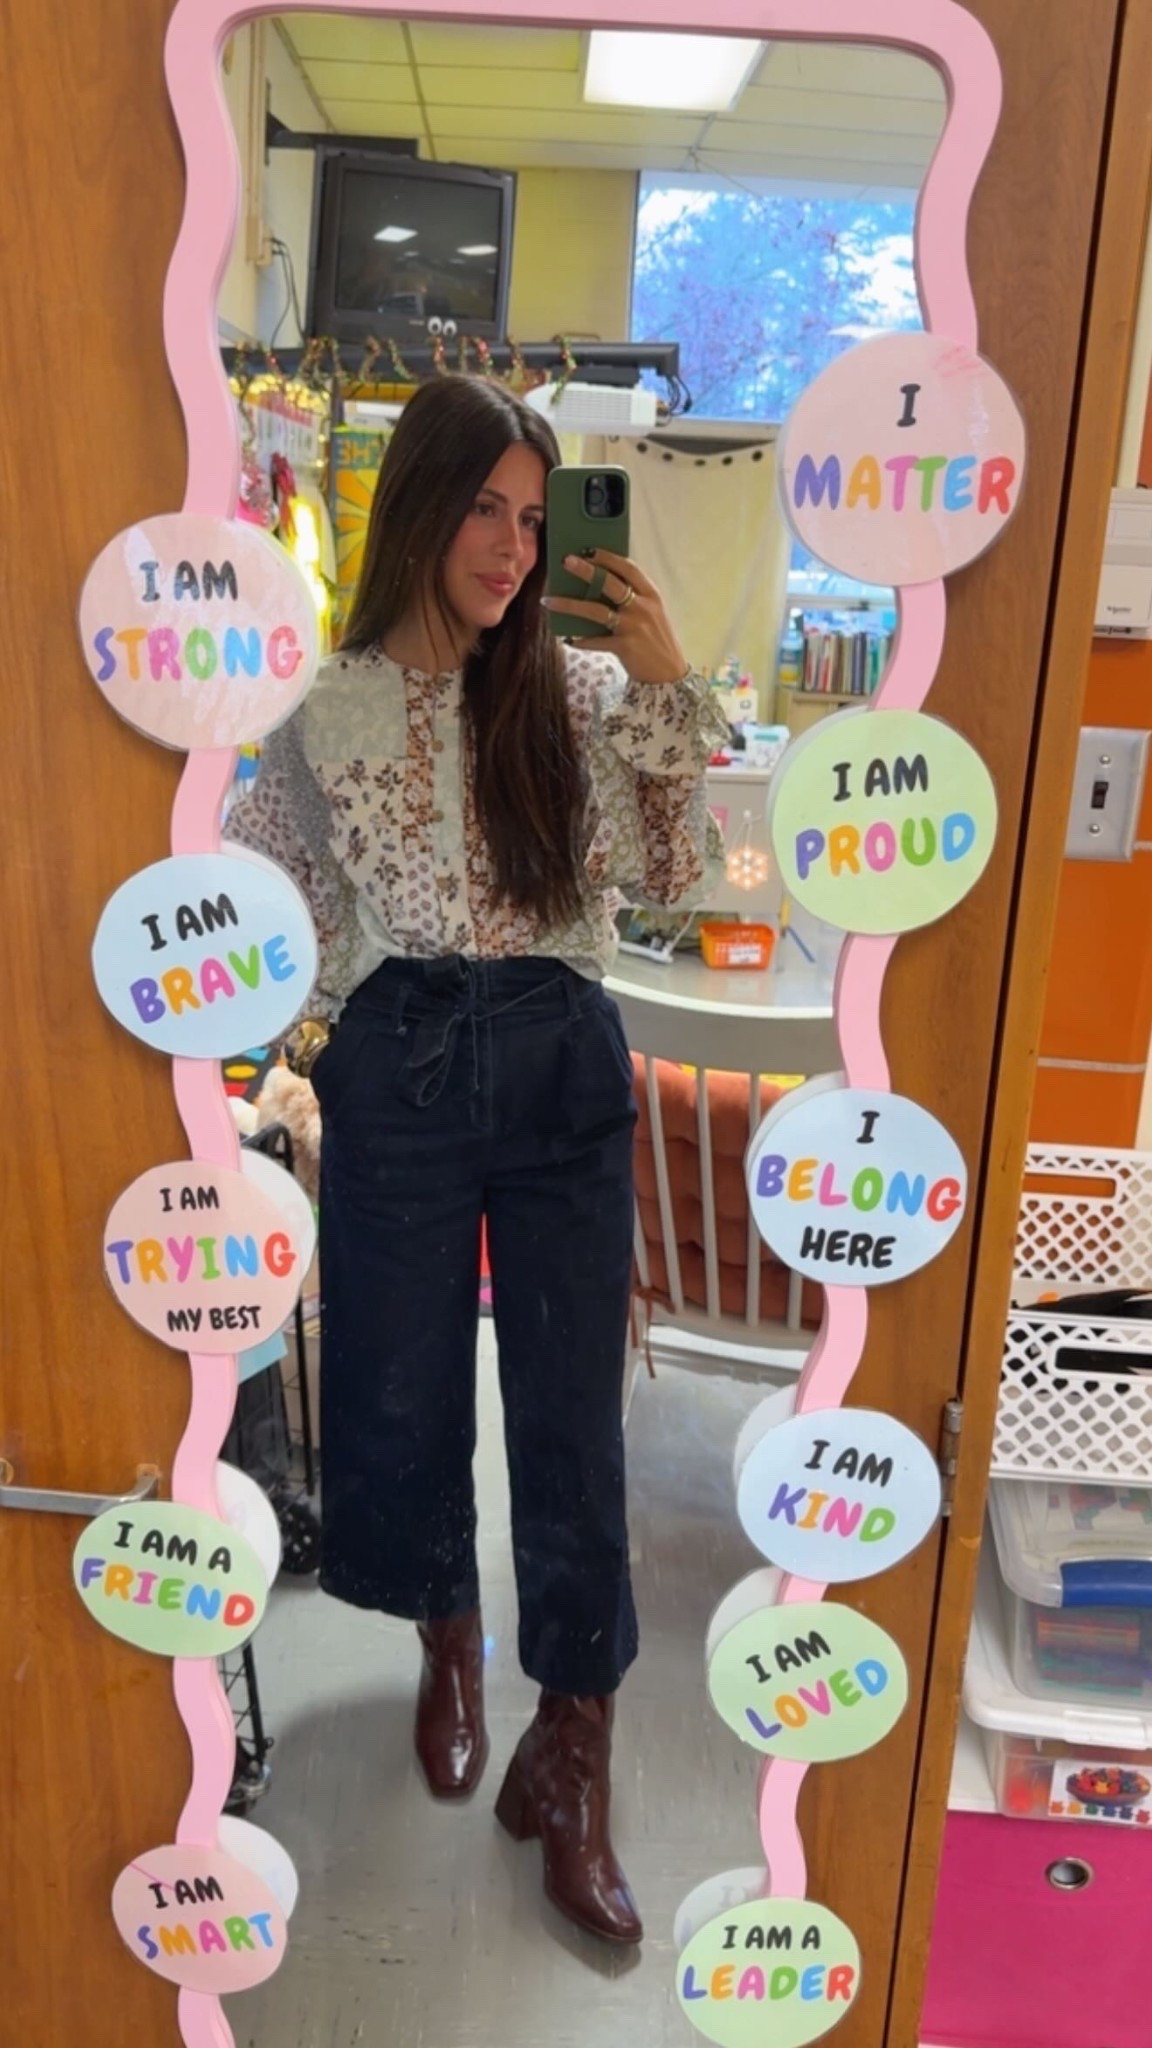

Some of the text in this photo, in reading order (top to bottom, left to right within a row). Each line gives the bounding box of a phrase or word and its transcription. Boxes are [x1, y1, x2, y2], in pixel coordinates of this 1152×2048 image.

[897, 383, 921, 427] I
[794, 454, 1015, 514] MATTER
[139, 560, 238, 601] I AM
[94, 626, 303, 681] STRONG
[833, 754, 928, 802] I AM
[796, 813, 975, 880] PROUD
[141, 893, 238, 951] I AM
[130, 935, 296, 1023] BRAVE
[856, 1110, 880, 1144] I
[160, 1186, 219, 1212] I AM
[757, 1155, 961, 1221] BELONG
[107, 1232, 296, 1284] TRYING
[800, 1226, 896, 1268] HERE
[167, 1306, 261, 1332] MY BEST
[804, 1440, 893, 1487] I AM
[768, 1483, 895, 1542] KIND
[114, 1521, 231, 1573] I AM A
[81, 1558, 254, 1626] FRIEND
[746, 1630, 831, 1683] I AM
[746, 1659, 887, 1739] LOVED
[148, 1876, 224, 1909] I AM
[138, 1913, 273, 1959] SMART
[722, 1925, 820, 1950] I AM A
[683, 1964, 854, 2002] LEADER
